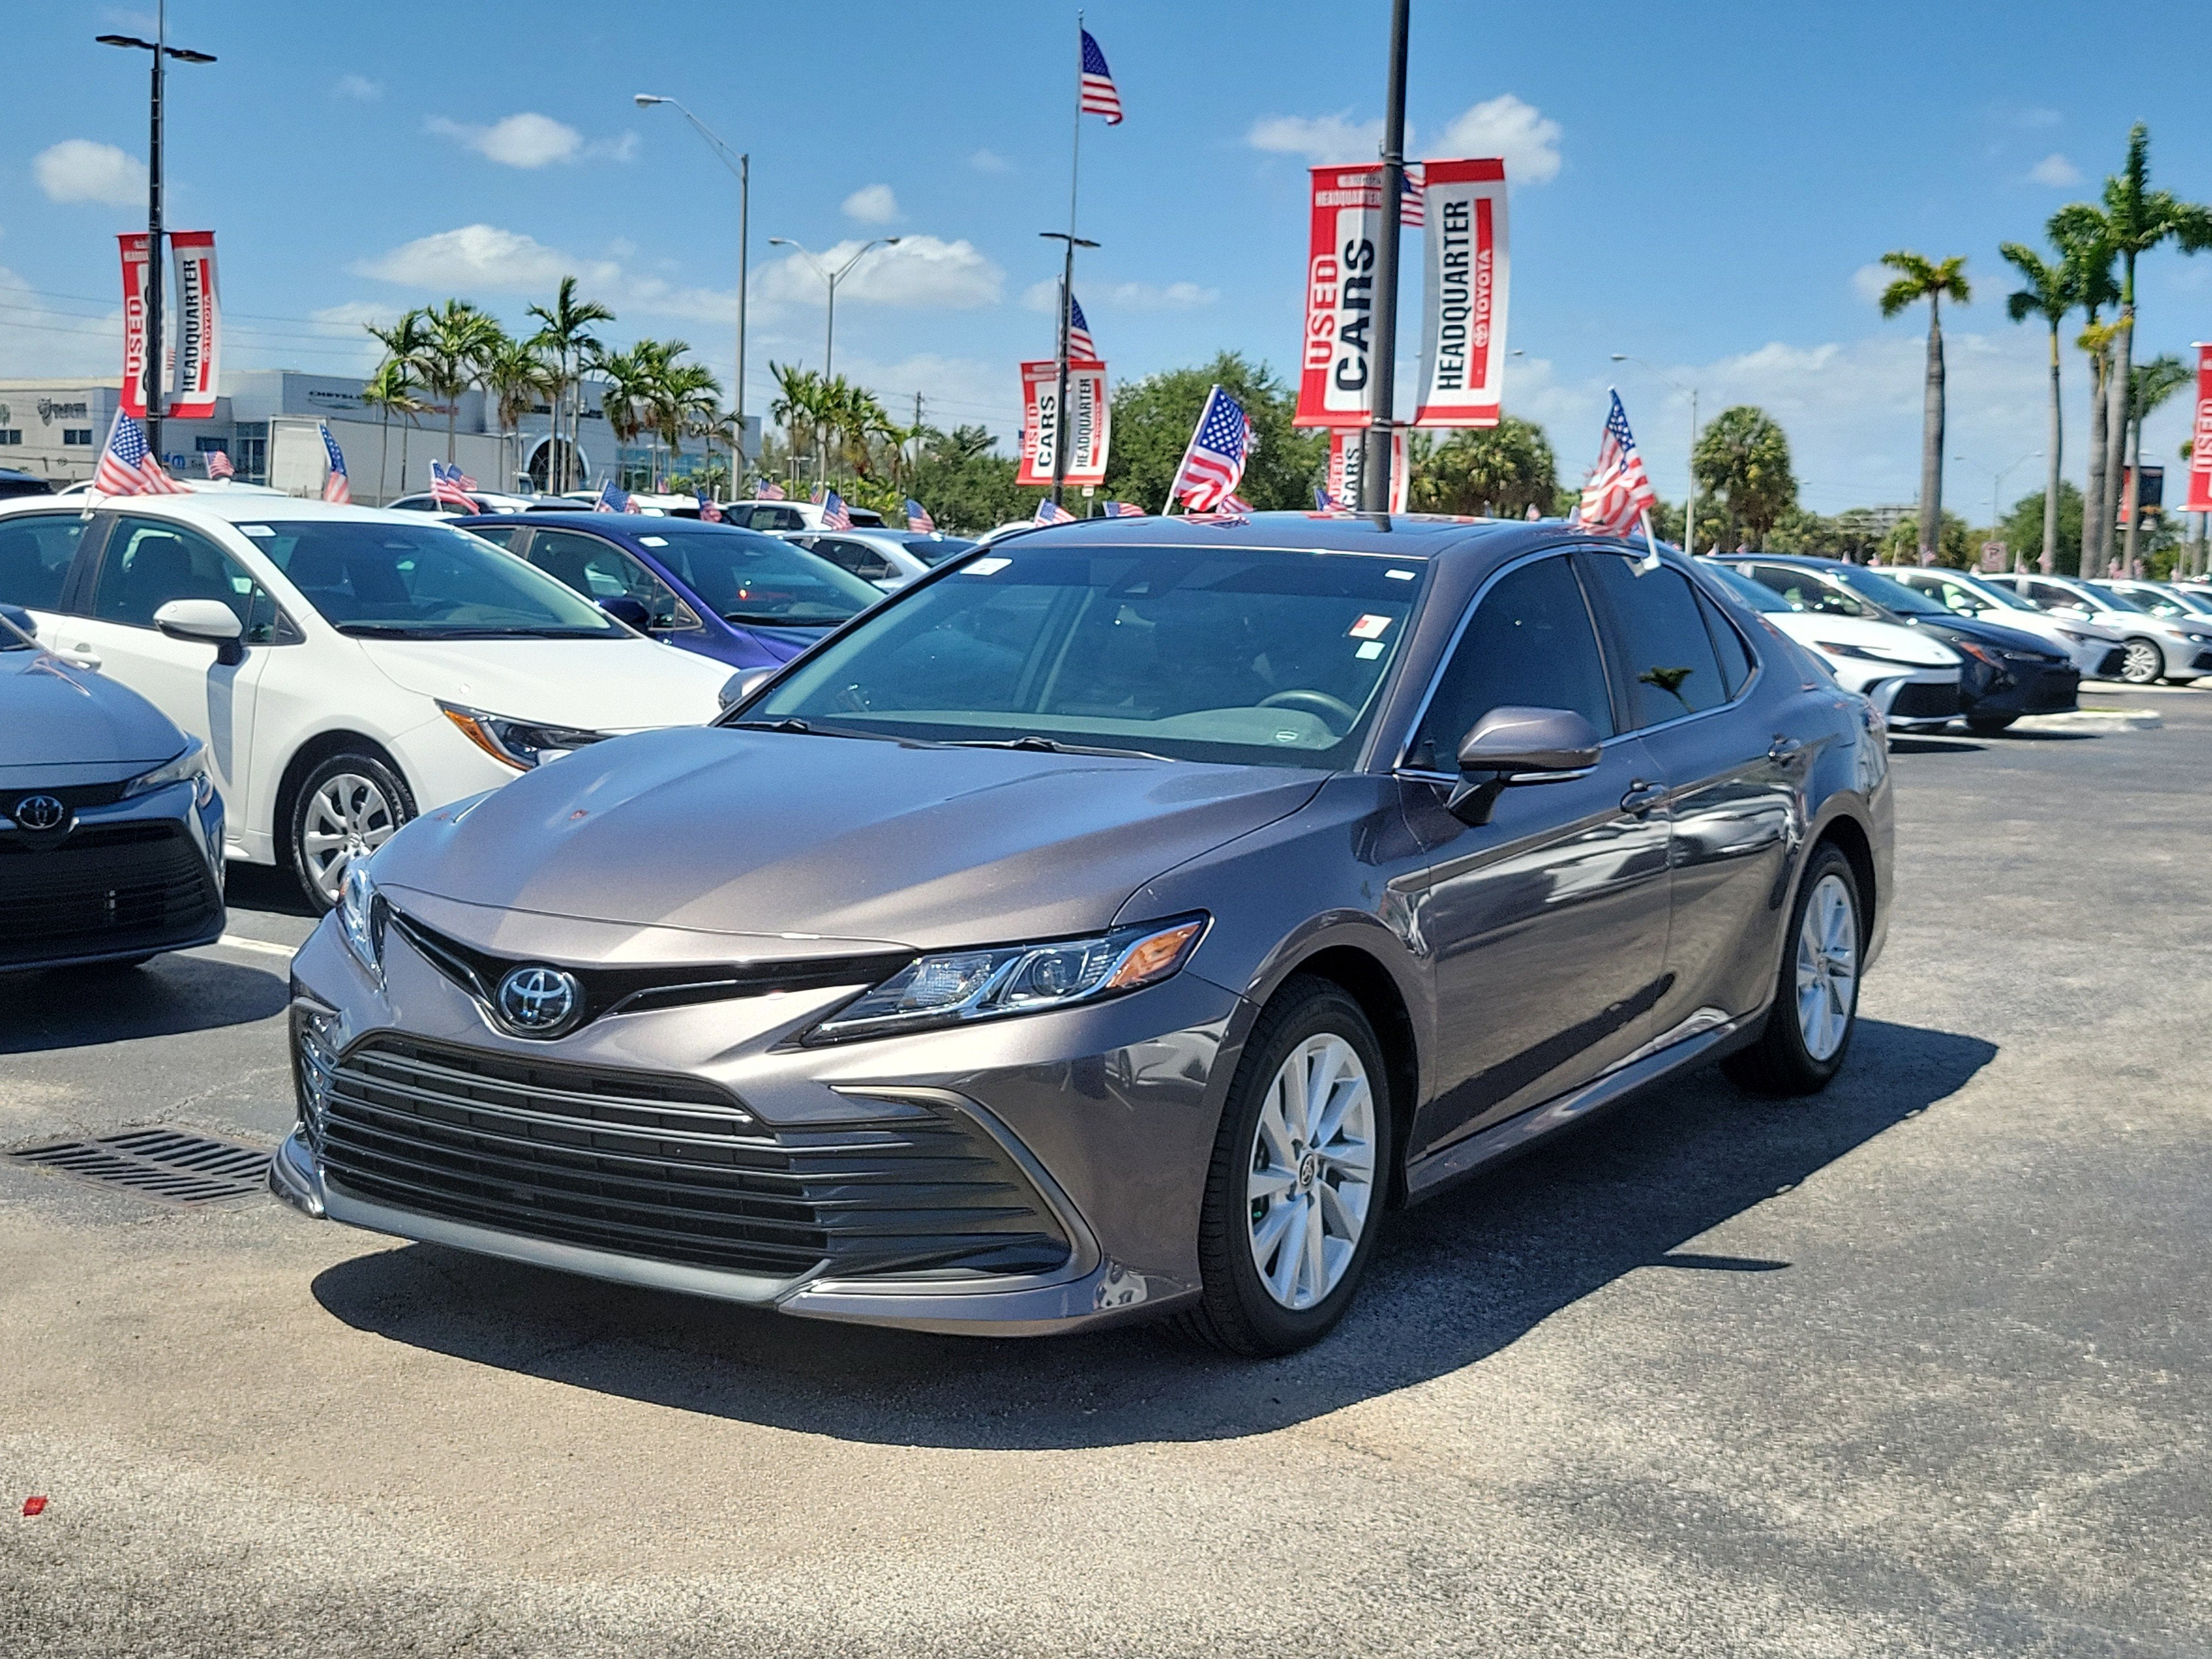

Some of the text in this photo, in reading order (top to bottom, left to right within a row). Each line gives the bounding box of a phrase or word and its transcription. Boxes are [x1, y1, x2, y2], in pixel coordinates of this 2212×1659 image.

[182, 258, 202, 392] HEADQUARTER
[1308, 257, 1338, 365] USED
[1336, 239, 1374, 391] CARS
[1436, 200, 1472, 390] HEADQUARTER
[1475, 248, 1492, 323] TOYOTA
[128, 300, 143, 374] USED
[1026, 405, 1039, 455] USED
[1038, 396, 1055, 467] CARS
[1076, 379, 1094, 467] HEADQUARTER
[1343, 448, 1359, 506] CARS
